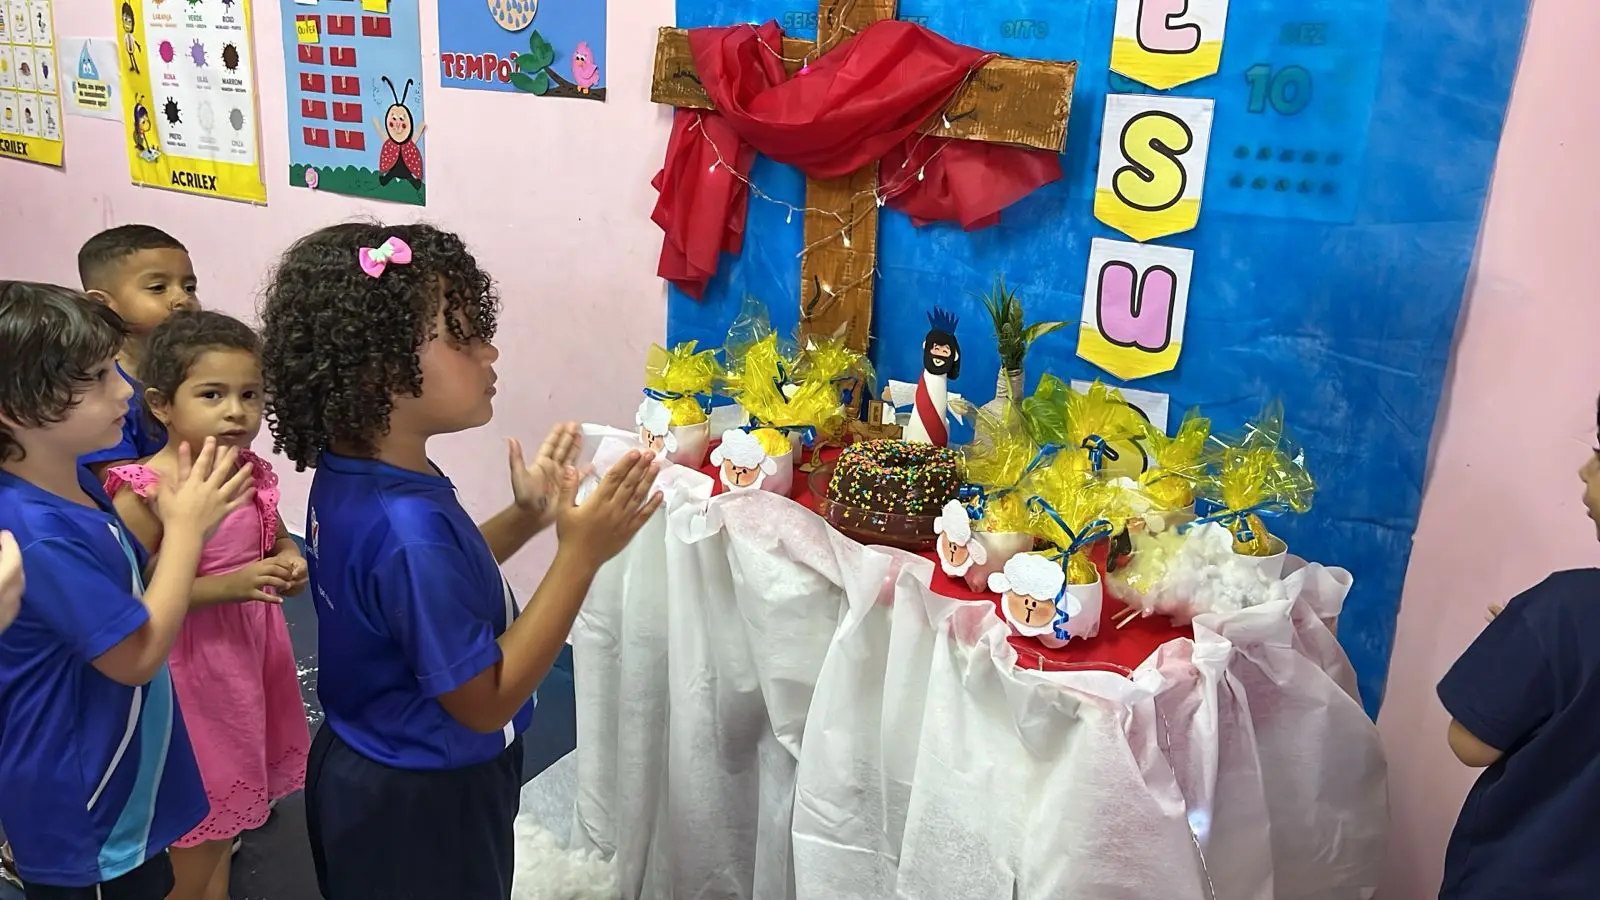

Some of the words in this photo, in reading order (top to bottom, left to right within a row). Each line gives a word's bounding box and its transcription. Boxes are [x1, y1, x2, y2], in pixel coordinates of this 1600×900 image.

[783, 11, 818, 29] SEIS
[1000, 19, 1050, 39] OITO
[1244, 63, 1313, 117] 10
[171, 170, 217, 191] ACRILEX
